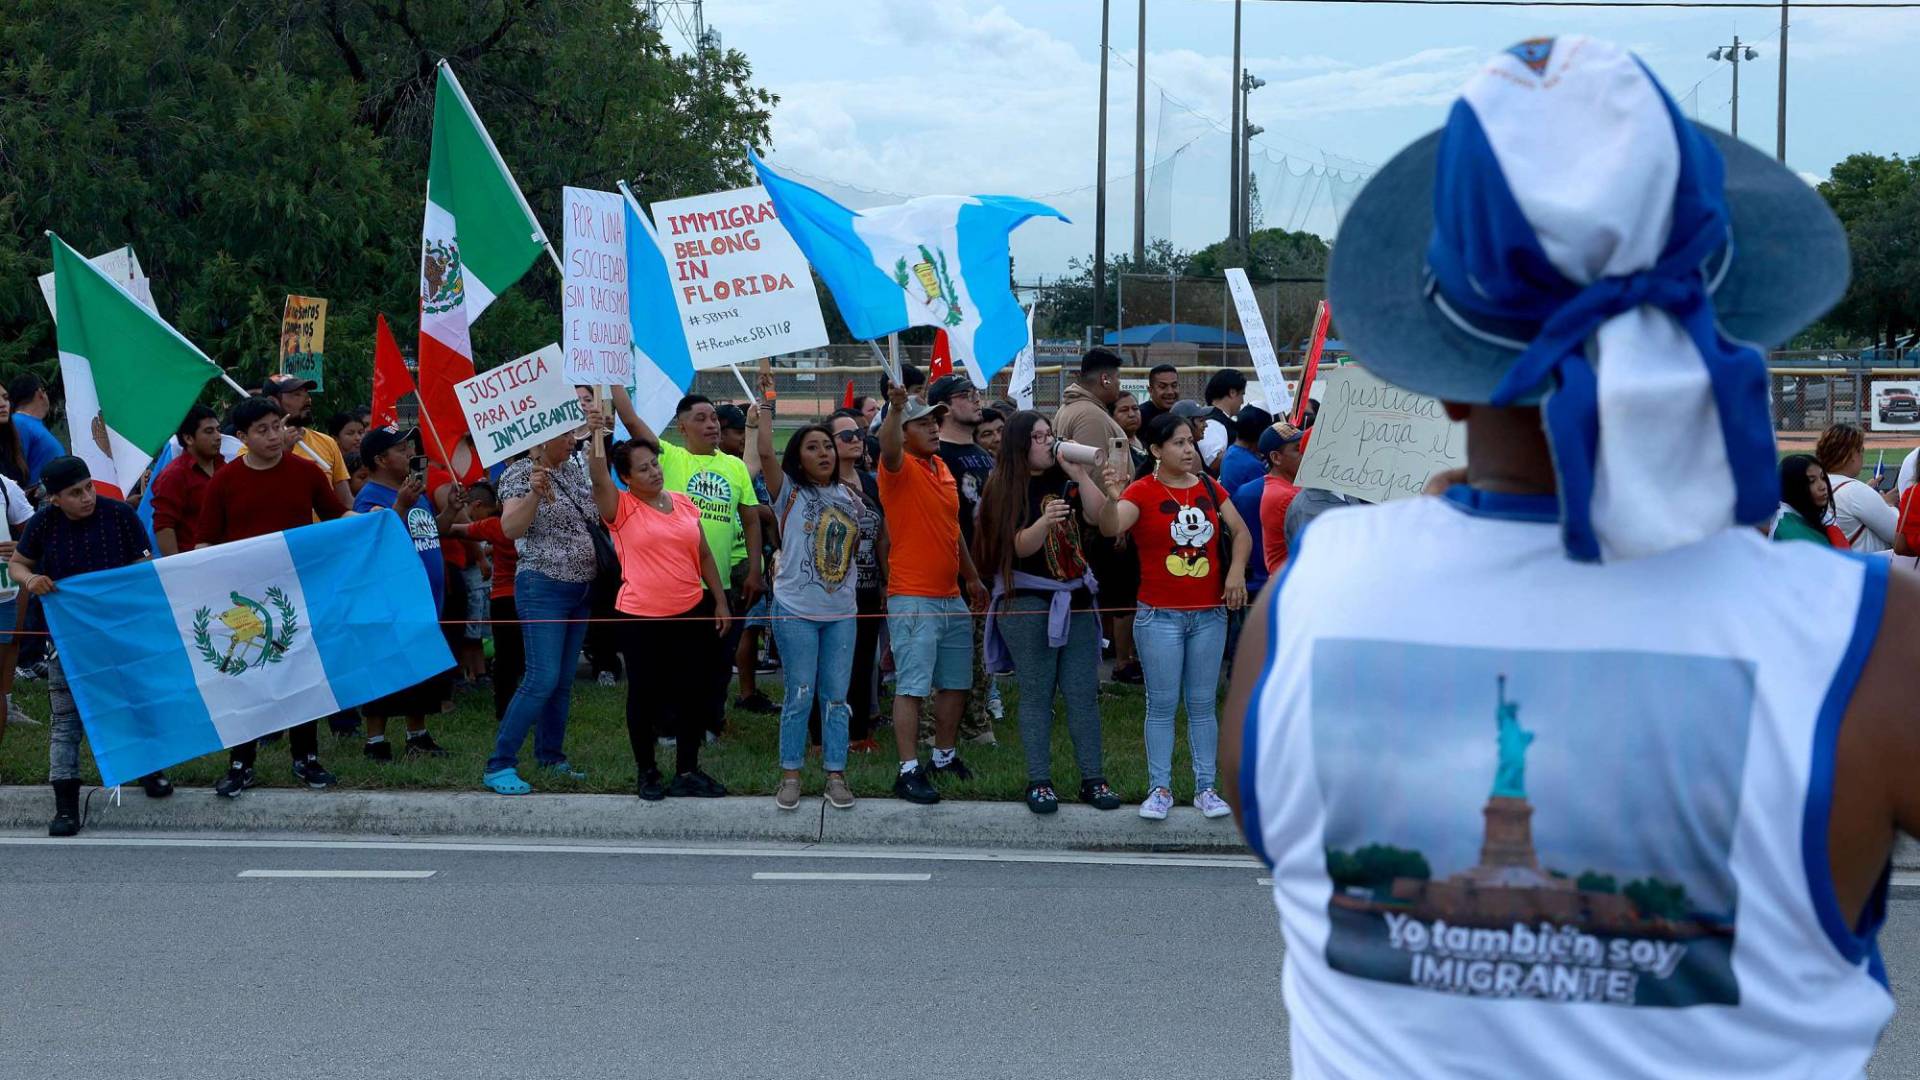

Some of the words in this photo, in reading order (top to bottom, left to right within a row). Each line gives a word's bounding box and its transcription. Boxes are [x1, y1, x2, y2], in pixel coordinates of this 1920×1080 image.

[572, 202, 597, 240] POR
[602, 210, 624, 247] UNA
[674, 229, 761, 259] BELONG
[572, 249, 626, 284] SOCIEDAD
[676, 259, 709, 281] IN
[566, 285, 585, 308] SIN
[590, 286, 629, 316] RACISMO
[683, 273, 795, 305] FLORIDA
[573, 319, 580, 341] E
[588, 321, 629, 346] IGUALDAD
[571, 347, 595, 374] PARA
[599, 350, 629, 376] TODOS
[464, 356, 548, 404] JUSTICIA
[473, 404, 509, 431] PARA
[1332, 379, 1444, 433] Justicia
[488, 399, 586, 453] INMIGRANTES
[1353, 419, 1418, 456] para
[1429, 424, 1456, 459] el
[1383, 911, 1427, 951] Yo
[1608, 937, 1686, 979] soy
[1410, 953, 1636, 1002] IMIGRANTE
